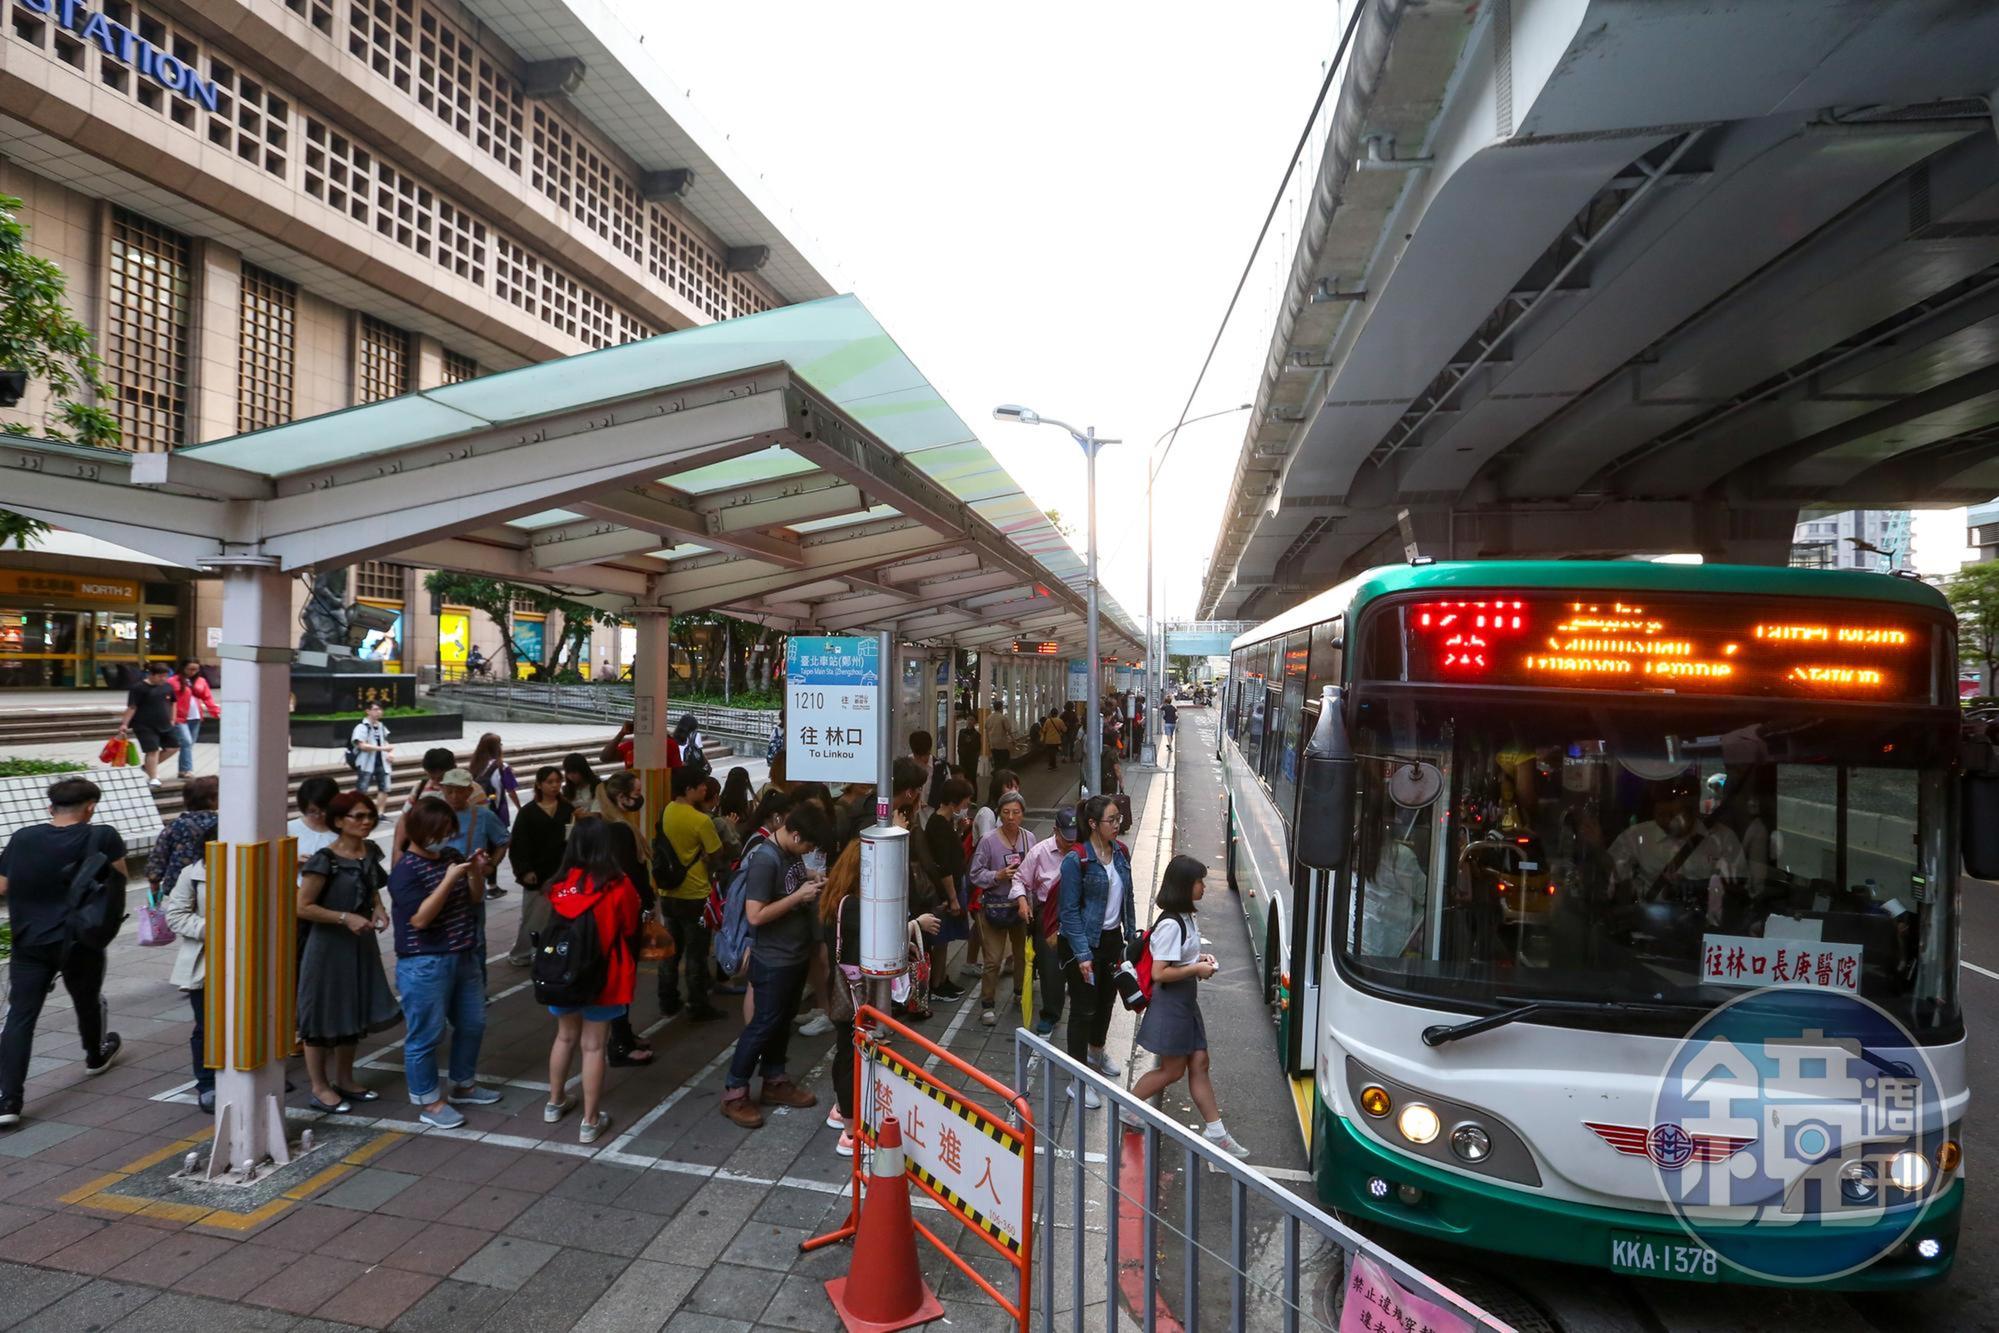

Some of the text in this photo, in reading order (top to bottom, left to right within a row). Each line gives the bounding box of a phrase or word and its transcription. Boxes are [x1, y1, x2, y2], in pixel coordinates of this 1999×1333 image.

[81, 583, 122, 596] NORTH
[124, 587, 132, 597] 2
[795, 692, 824, 709] 1210
[809, 749, 854, 759] To Linkou
[1705, 945, 1857, 989] 往林口長庚醫院
[874, 1078, 1001, 1205] 禁止進入
[1613, 1239, 1718, 1276] KKA-1378
